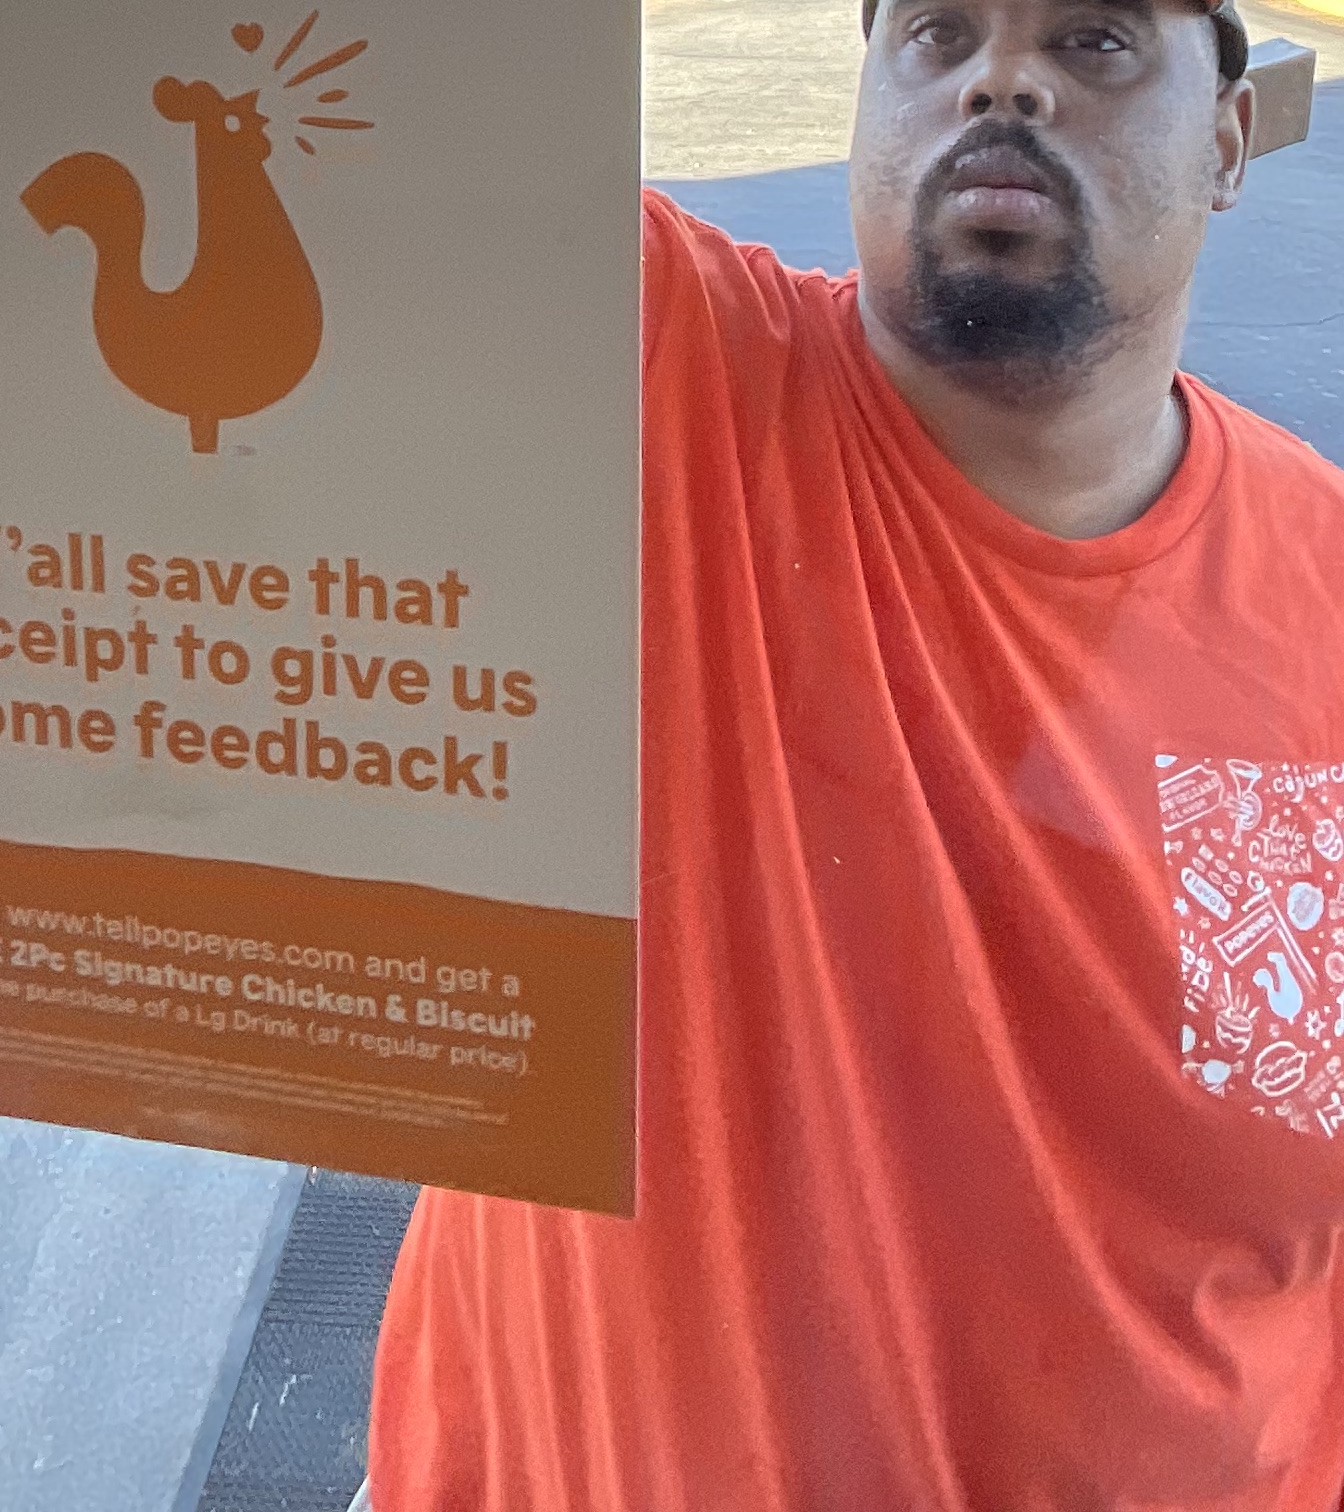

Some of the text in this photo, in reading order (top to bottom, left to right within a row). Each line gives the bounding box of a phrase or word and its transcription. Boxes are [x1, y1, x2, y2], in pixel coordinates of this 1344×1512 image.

[126, 553, 290, 611] save
[308, 557, 469, 628] that
[174, 623, 250, 685] to
[270, 634, 430, 706] give
[452, 664, 537, 717] us
[133, 699, 509, 801] feedback!
[10, 938, 66, 973] 2Pc
[73, 948, 234, 998] Signature
[241, 973, 378, 1020] Chicken
[385, 993, 409, 1024] &
[416, 997, 536, 1042] Biscuit
[365, 955, 427, 985] and
[436, 965, 493, 994] get
[501, 974, 521, 997] a
[26, 982, 138, 1014] purchase
[143, 998, 171, 1019] of
[175, 1004, 189, 1023] a
[195, 1003, 226, 1033] Lg
[233, 1009, 301, 1039] Drink
[307, 1019, 342, 1046] (at
[349, 1029, 443, 1060] regular
[449, 1044, 529, 1078] price)
